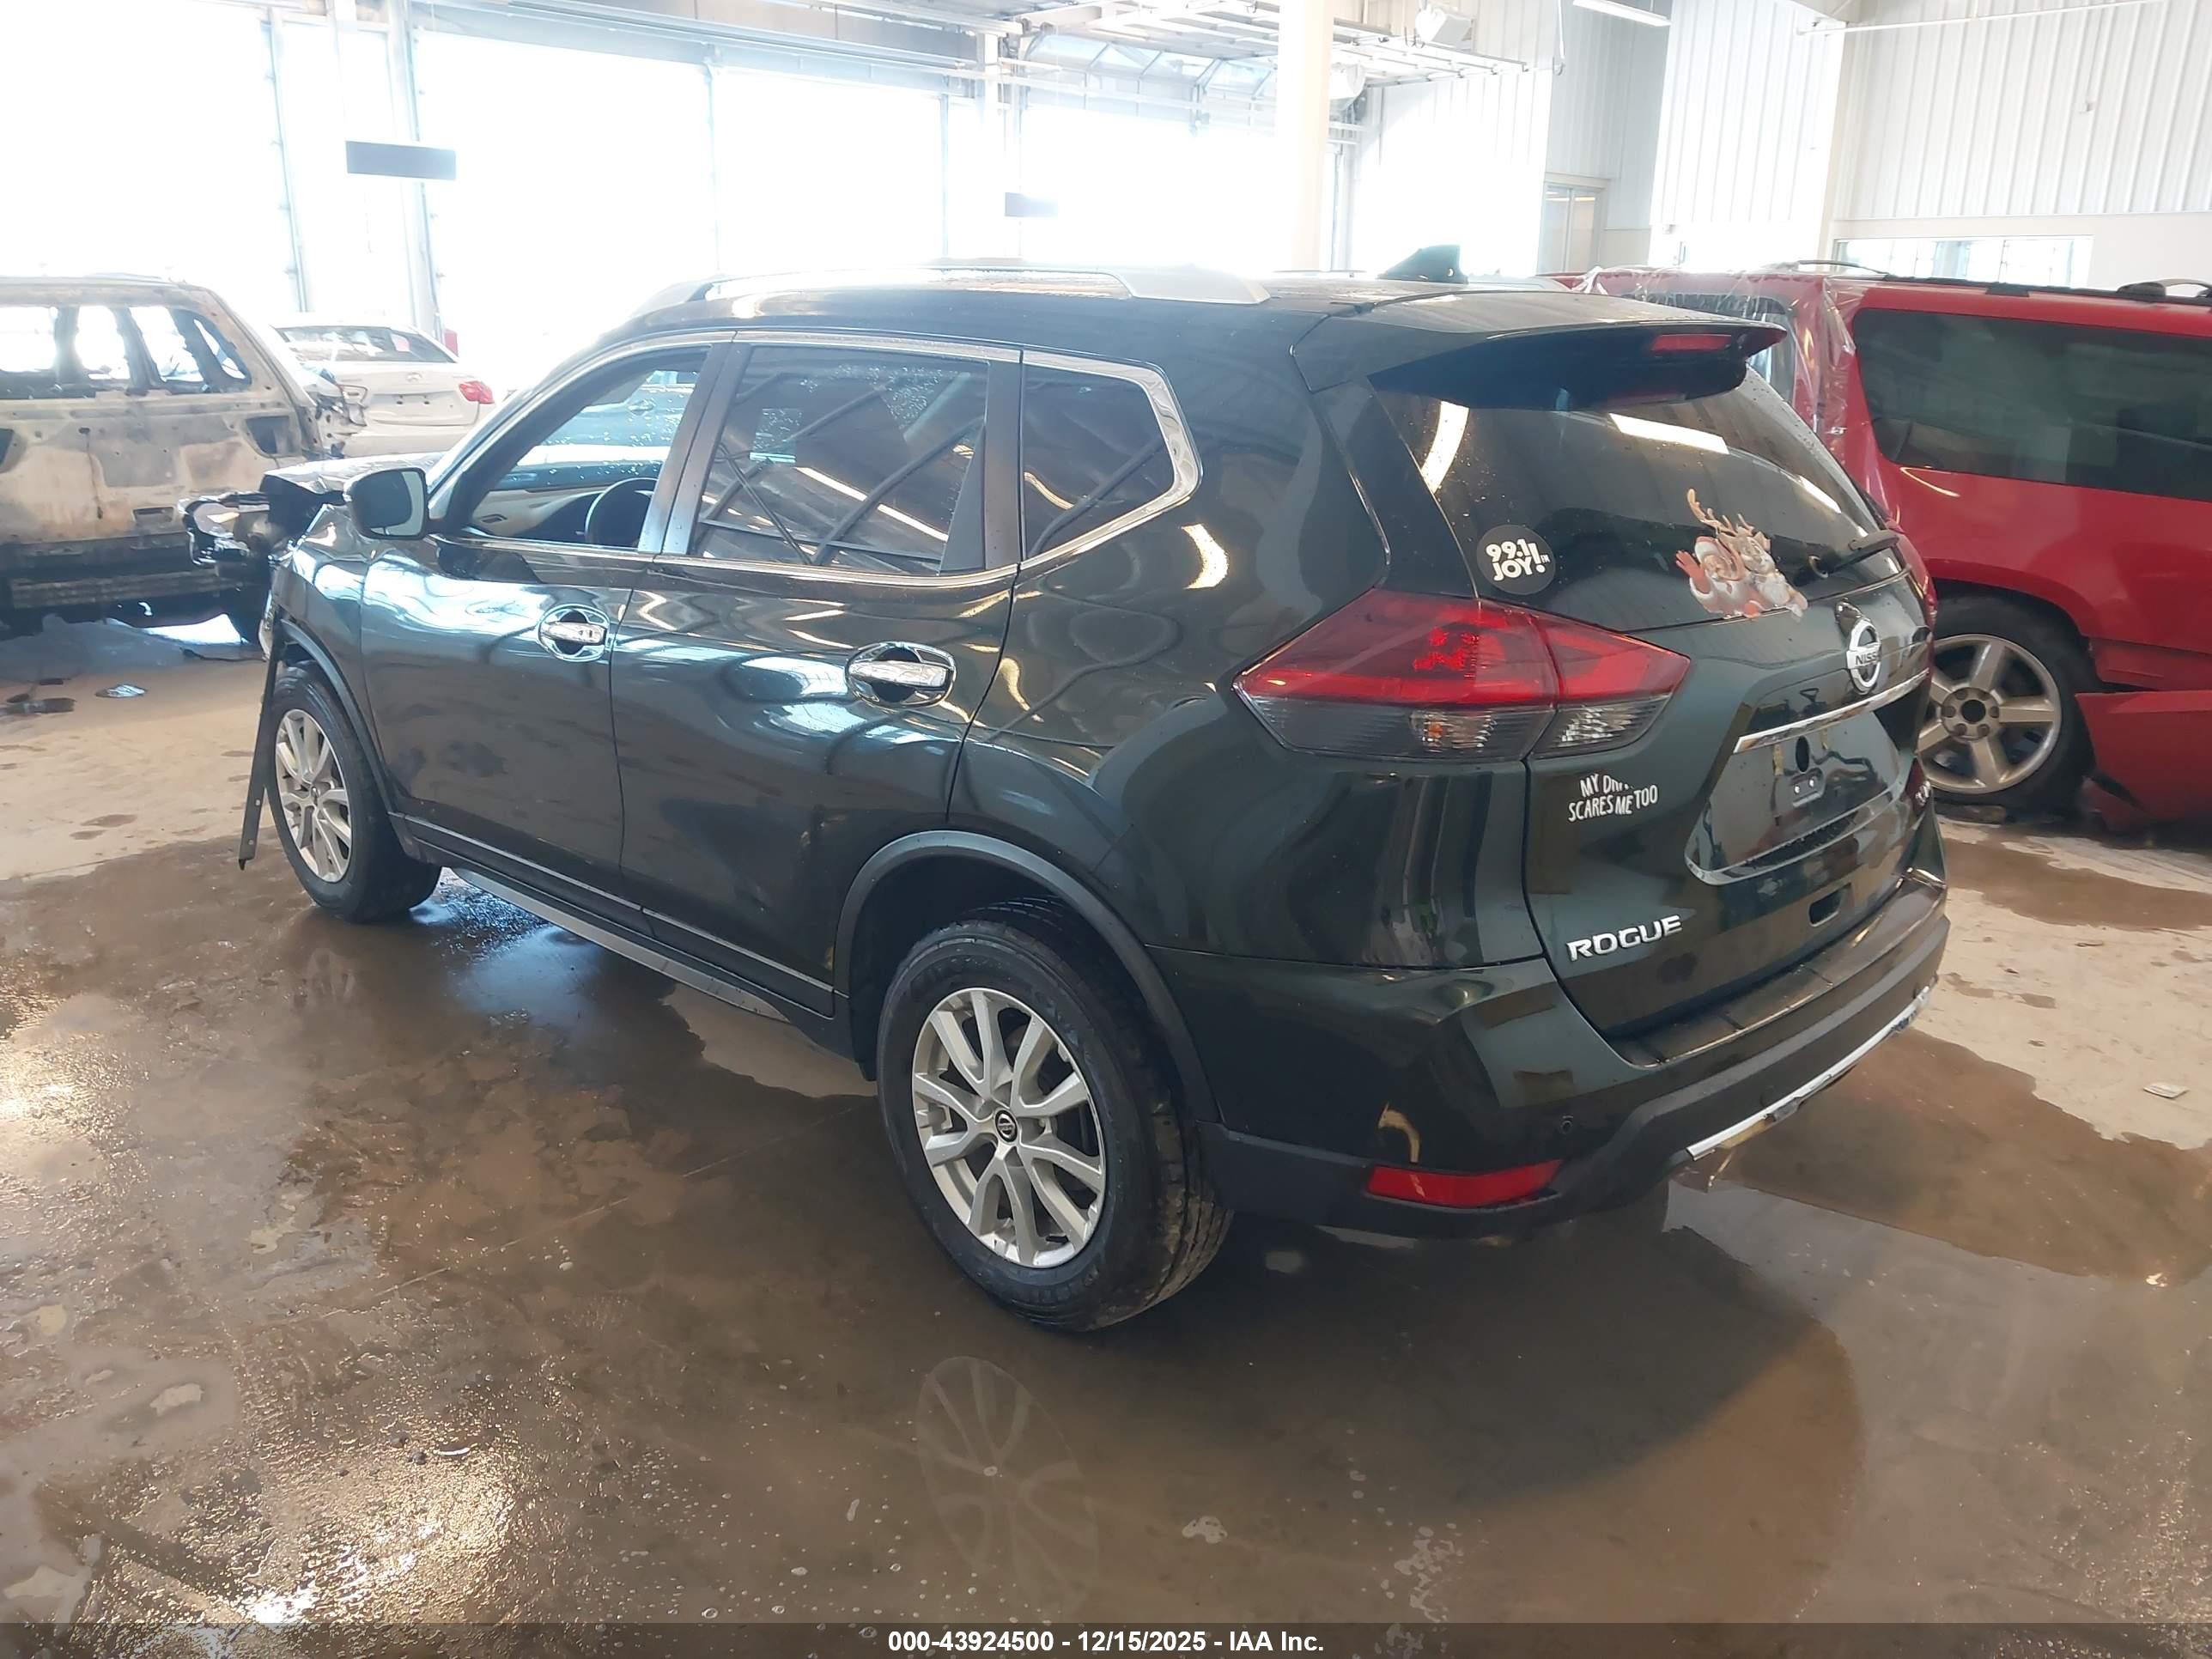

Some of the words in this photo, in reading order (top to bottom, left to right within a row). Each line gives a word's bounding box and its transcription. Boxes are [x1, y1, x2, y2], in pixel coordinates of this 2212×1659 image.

[1486, 538, 1531, 562] 99.1
[1492, 543, 1546, 581] JOY!
[1567, 794, 1614, 822] SCARES
[1614, 795, 1634, 815] ME
[1633, 784, 1659, 810] TOO
[1579, 773, 1600, 798] MY
[1566, 915, 1683, 962] ROGUE
